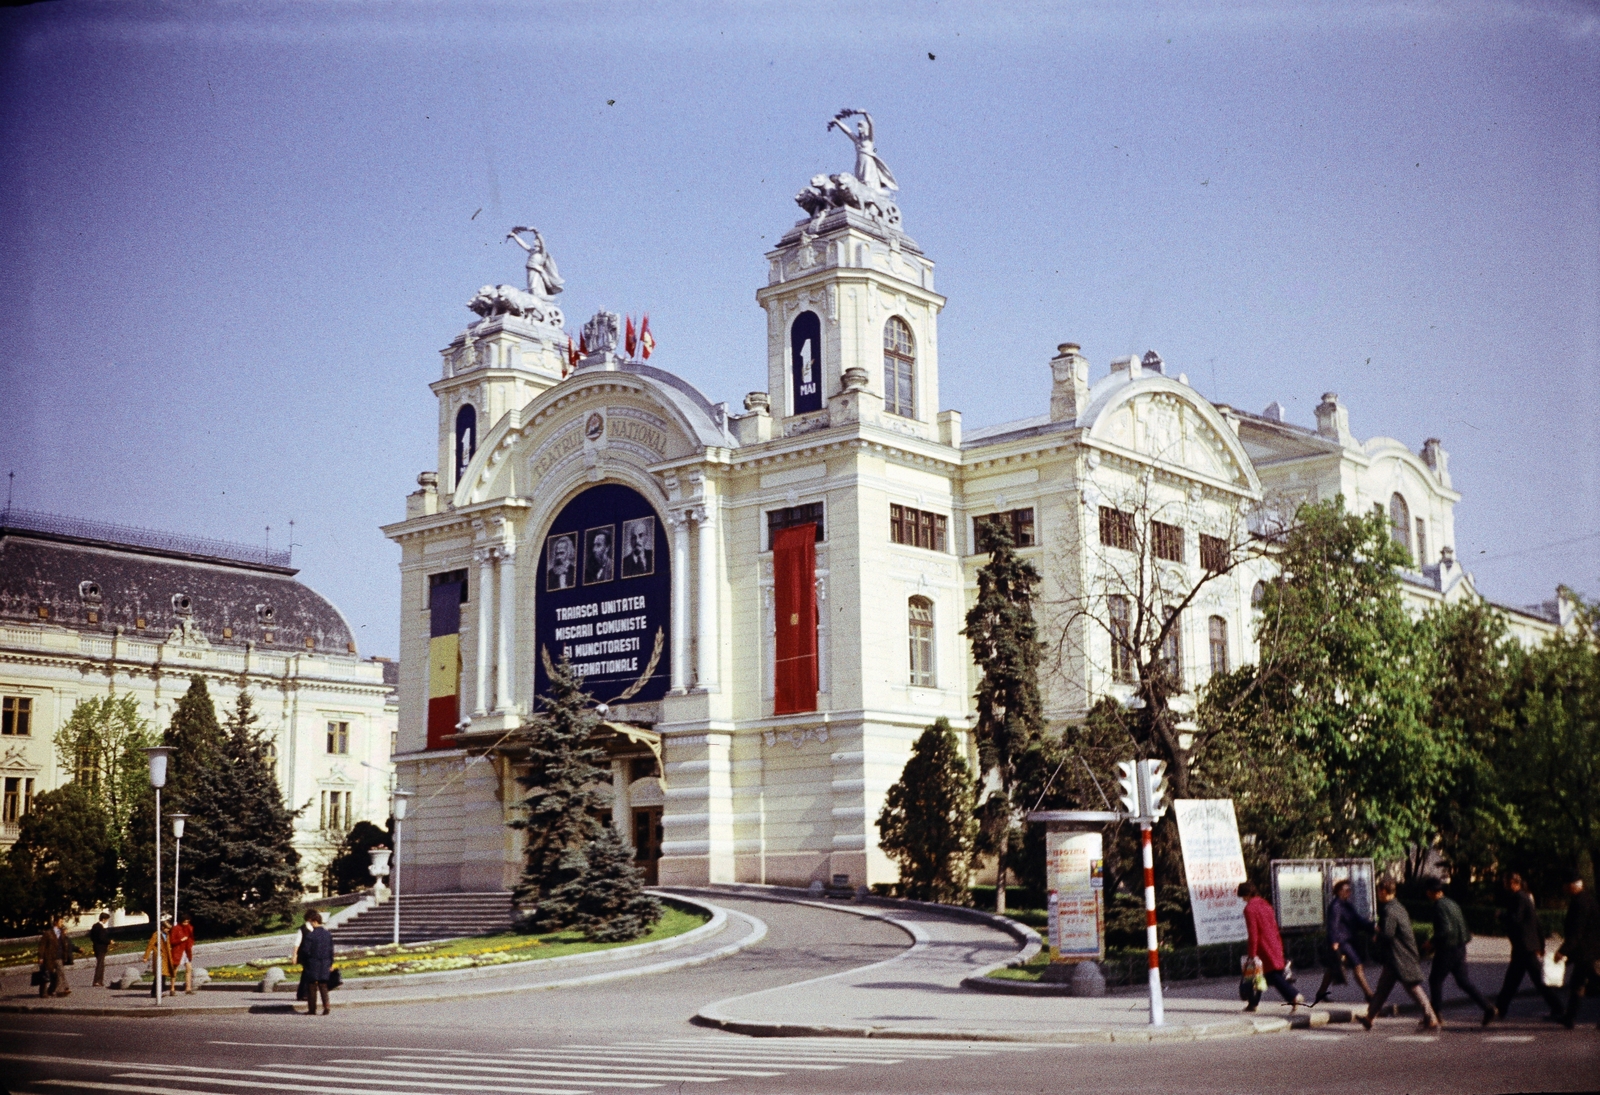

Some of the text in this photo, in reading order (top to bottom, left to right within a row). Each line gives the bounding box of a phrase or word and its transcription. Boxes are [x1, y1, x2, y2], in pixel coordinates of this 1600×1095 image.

[800, 338, 812, 384] 1
[800, 383, 816, 396] MAI
[534, 419, 667, 477] TEATRUL NATIONAL
[556, 595, 646, 621] TRAIASCA UNITATEA
[555, 615, 647, 641] MISCARII COMUNISTE
[575, 637, 640, 657] MUNCITORESTI
